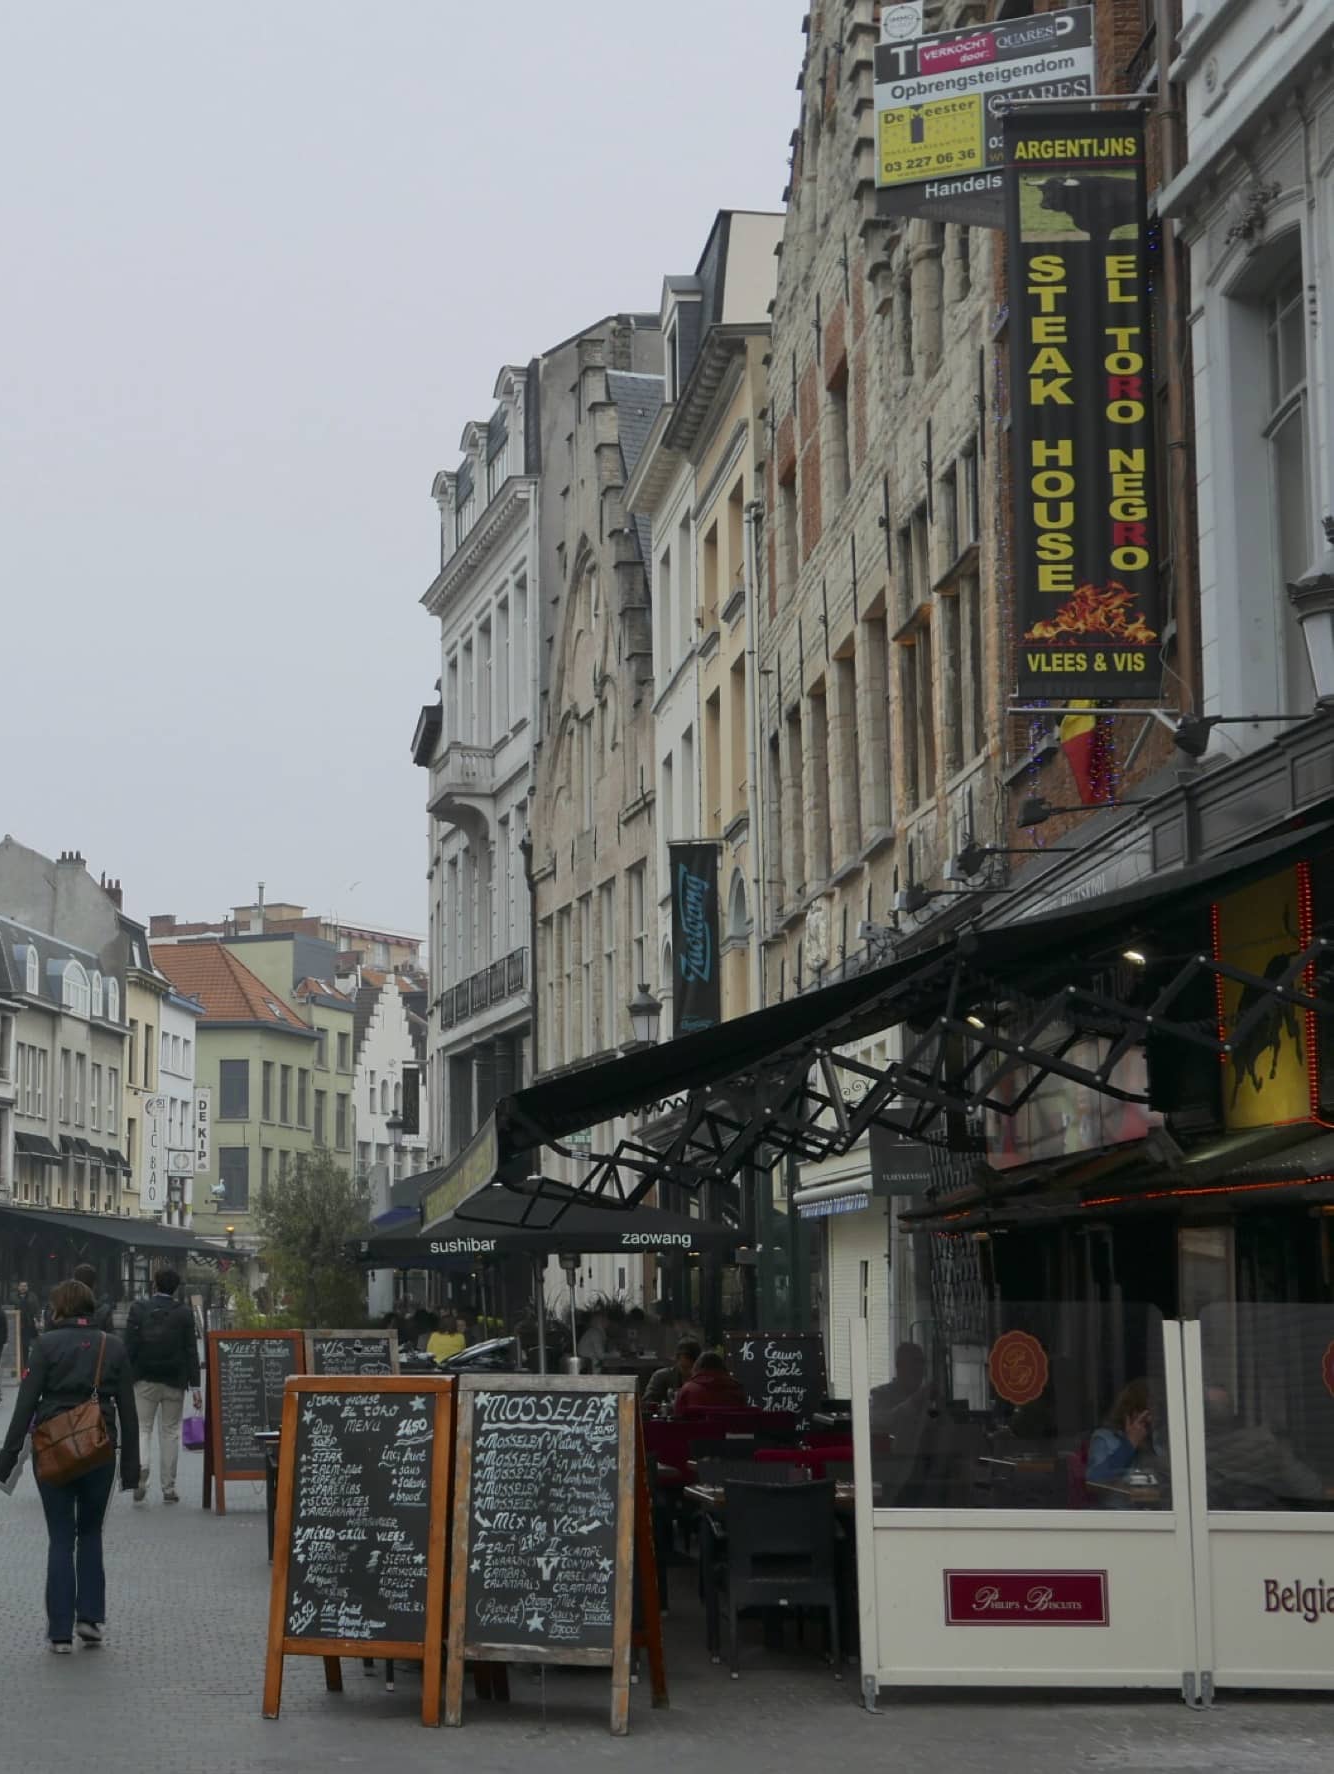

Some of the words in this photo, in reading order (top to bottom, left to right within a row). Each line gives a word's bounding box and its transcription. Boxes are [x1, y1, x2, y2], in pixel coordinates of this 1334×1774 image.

[923, 37, 988, 60] VERKOCHT
[996, 25, 1055, 48] QUARES
[891, 56, 1075, 100] Opbrengsteigendom
[884, 113, 905, 125] De
[1014, 137, 1137, 160] ARGENTIJNS
[885, 161, 902, 173] 03
[906, 155, 931, 169] 227
[936, 152, 954, 164] 06
[959, 149, 976, 160] 36
[1105, 255, 1138, 303] EL
[1027, 255, 1074, 405] STEAK
[1104, 327, 1145, 424] TORO
[1030, 440, 1075, 592] HOUSE
[1108, 449, 1150, 571] NEGRO
[1027, 652, 1087, 672] VLEES
[1094, 653, 1108, 672] &
[1113, 652, 1145, 672] VIS
[199, 1101, 207, 1122] DE
[198, 1128, 207, 1160] KIP
[429, 1238, 497, 1253] sushibar
[621, 1232, 692, 1248] zaowang
[484, 1395, 615, 1424] MOSSELEN
